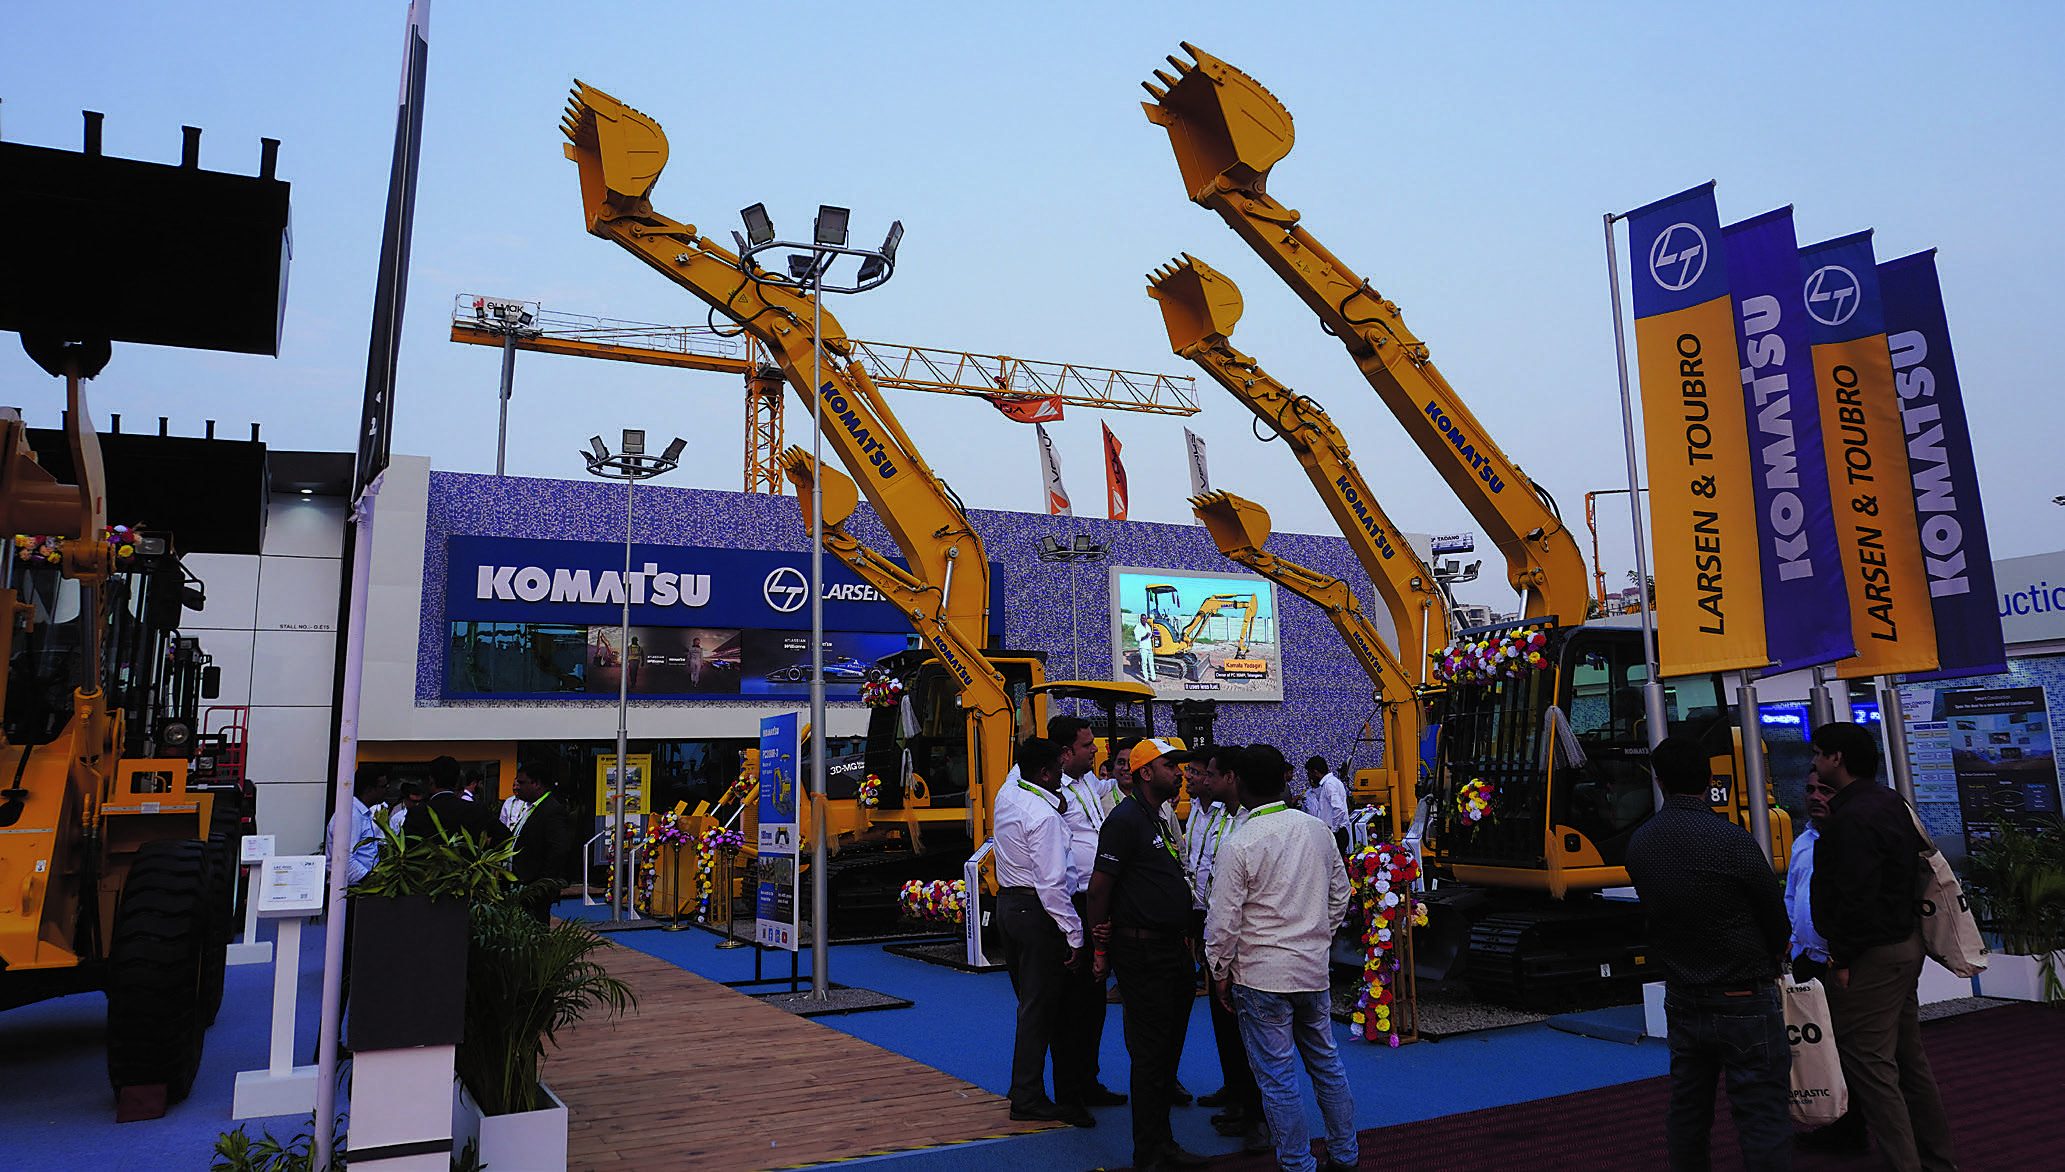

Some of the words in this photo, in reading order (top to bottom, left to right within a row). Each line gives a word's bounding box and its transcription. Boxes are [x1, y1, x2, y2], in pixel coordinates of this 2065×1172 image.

[820, 381, 898, 479] KOMATSU
[1424, 400, 1505, 494] KOMATSU
[1676, 334, 1714, 466] TOUBRO
[1740, 295, 1814, 582] KOMATSU
[1832, 365, 1875, 485] TOUBRO
[1690, 475, 1717, 499] &
[1851, 494, 1880, 517] &
[1888, 330, 1971, 598] KOMATSU
[1336, 475, 1395, 560] KOMATSU
[477, 562, 711, 607] KOMATSU
[1693, 510, 1725, 635] LARSEN
[1855, 526, 1898, 642] LARSEN
[932, 635, 973, 686] KOMATSU
[1353, 631, 1383, 674] KOMATSU
[1710, 787, 1728, 802] 81
